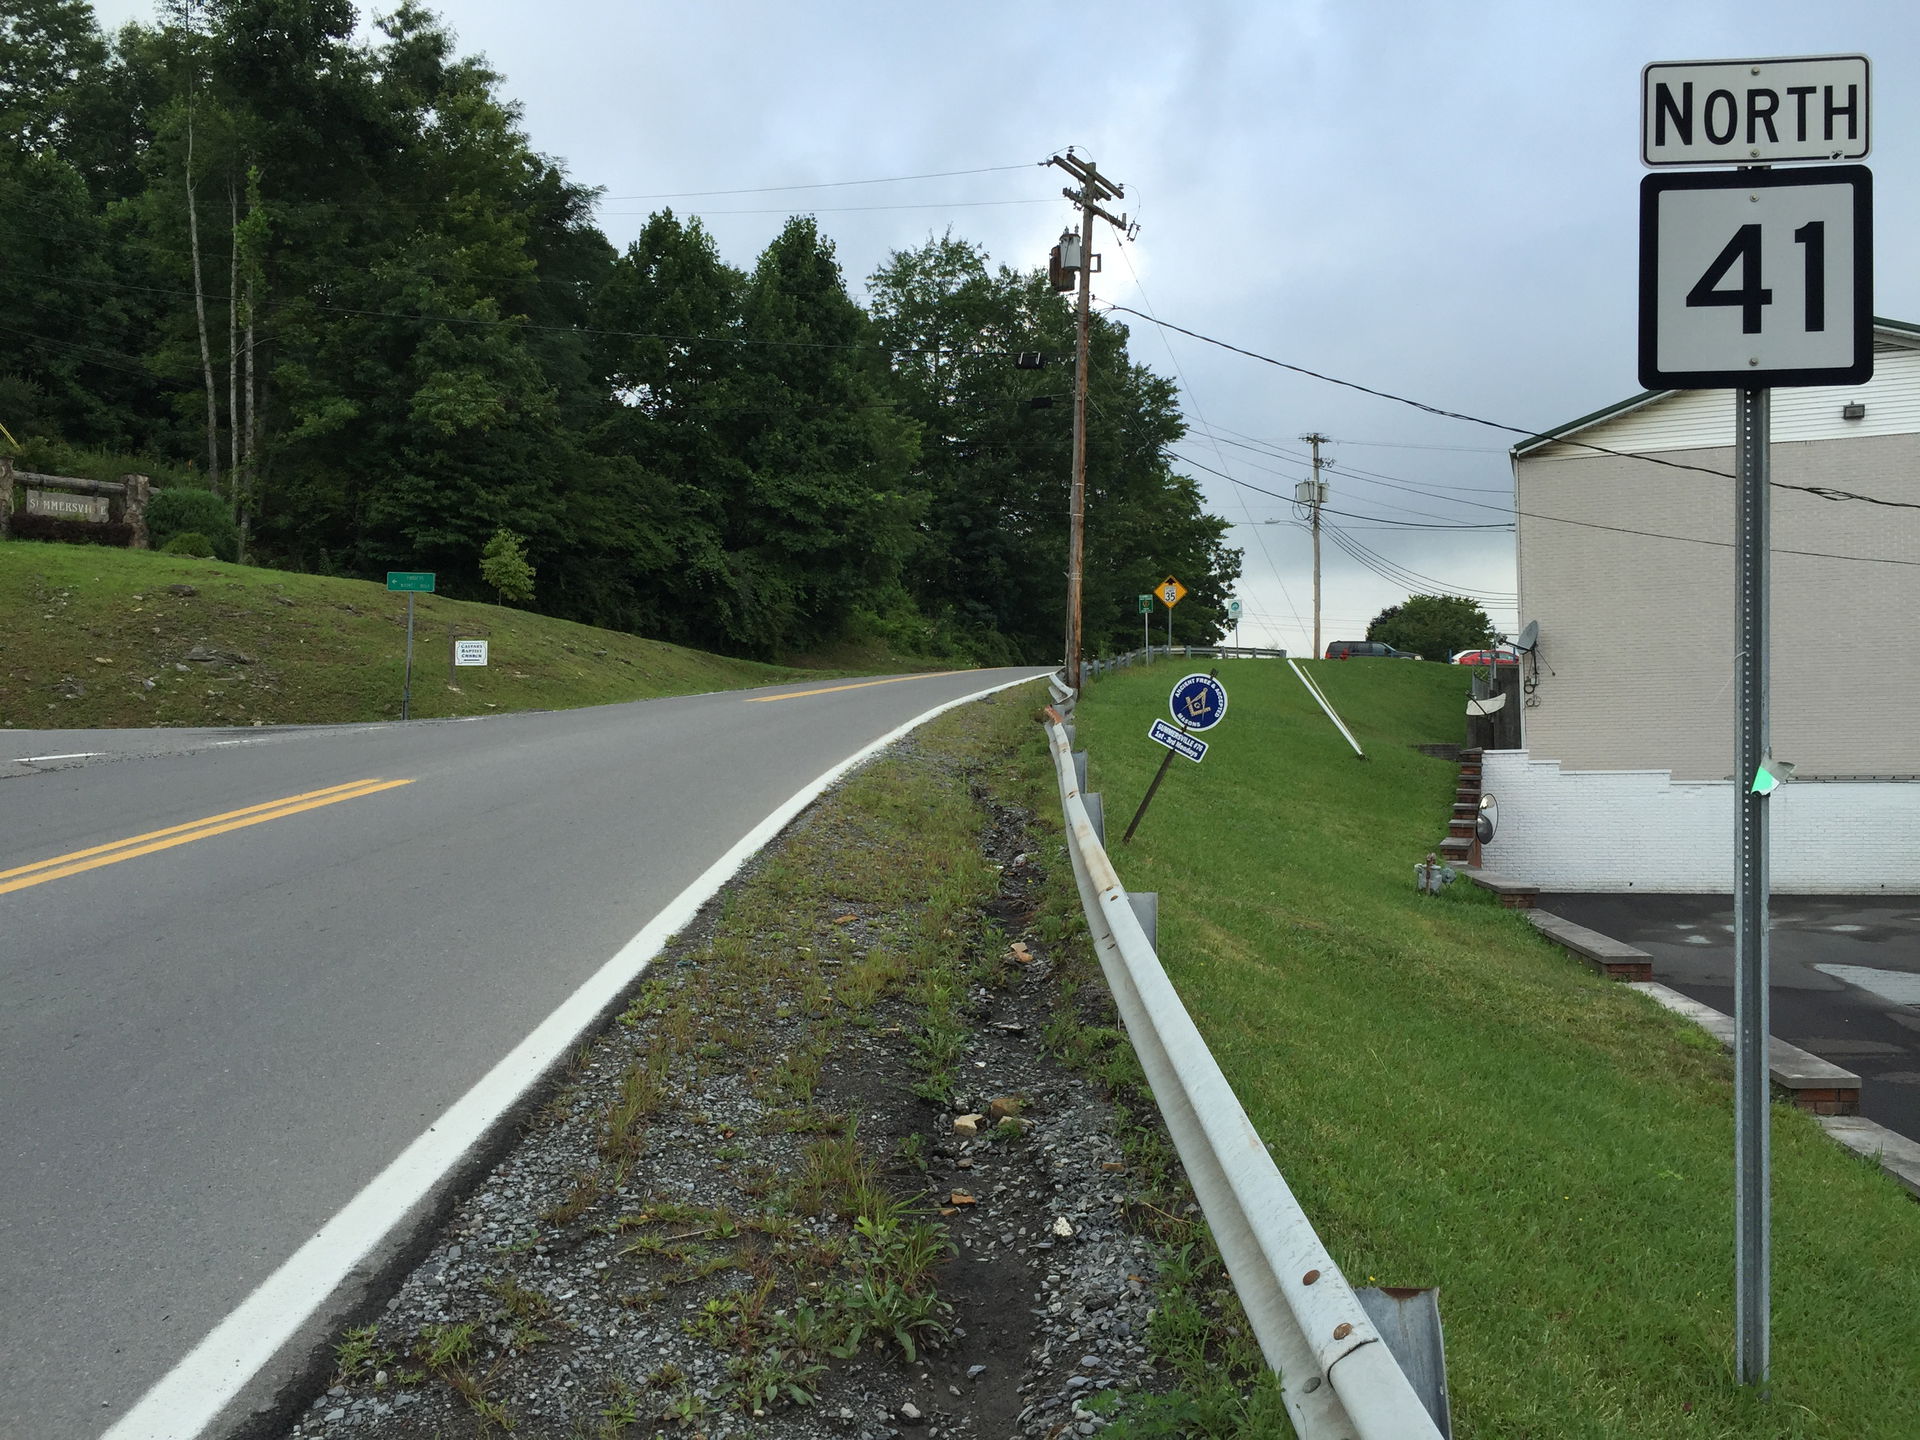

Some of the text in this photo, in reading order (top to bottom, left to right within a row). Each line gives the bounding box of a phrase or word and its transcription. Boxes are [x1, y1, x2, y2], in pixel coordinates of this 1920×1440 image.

[1655, 82, 1857, 146] NORTH
[1686, 221, 1824, 334] 41
[30, 498, 106, 515] SMMERSVILE
[1165, 592, 1175, 602] 35
[1175, 678, 1195, 698] ANCIENT
[1196, 678, 1211, 686] FREE
[1214, 688, 1224, 718] ACCEPTED
[1177, 713, 1200, 727] MASONS
[1154, 730, 1165, 740] 1st
[1166, 736, 1177, 746] 3rd
[1175, 741, 1199, 758] Mondays
[1157, 723, 1195, 748] SUMMERSVILLE
